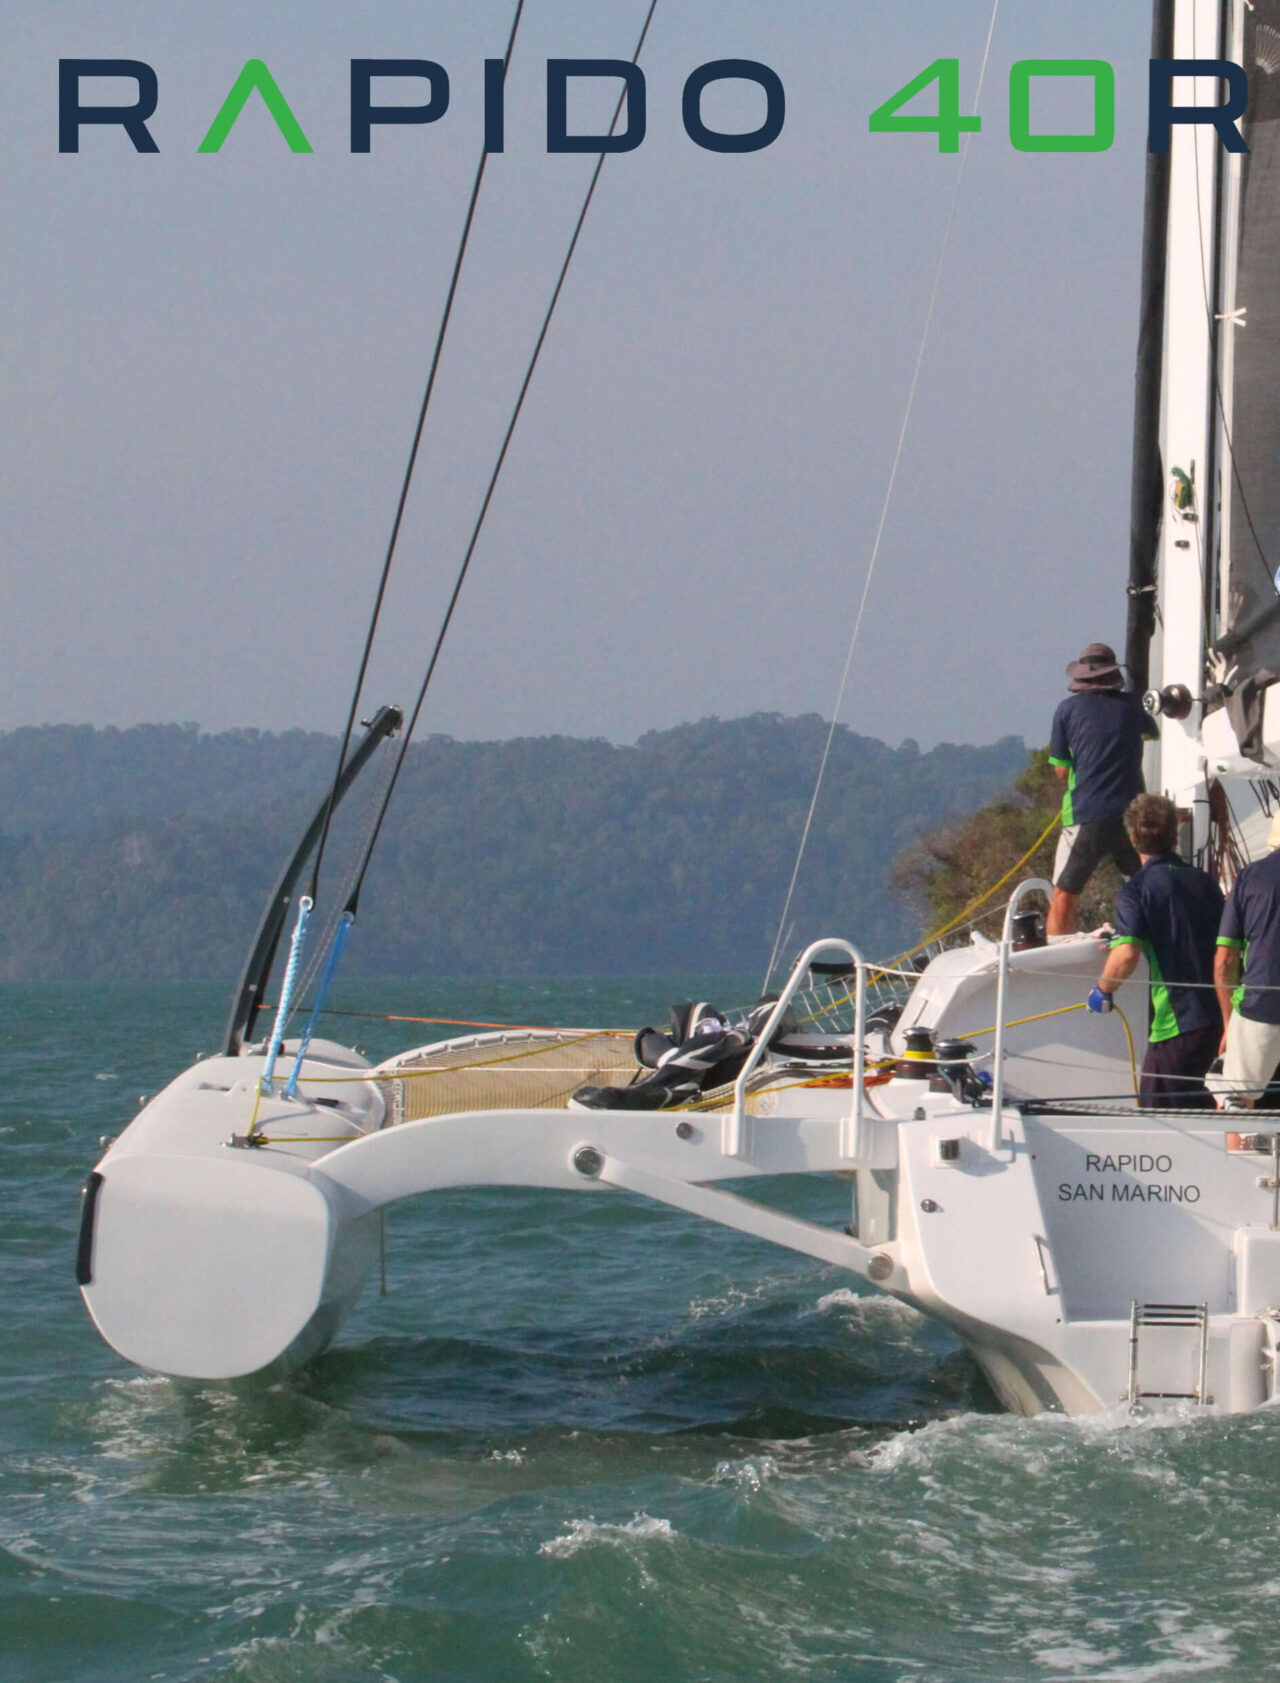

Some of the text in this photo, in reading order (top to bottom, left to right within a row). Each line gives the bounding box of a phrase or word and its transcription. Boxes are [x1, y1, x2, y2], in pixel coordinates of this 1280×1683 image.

[1085, 1154, 1173, 1173] RAPIDO
[1057, 1183, 1201, 1203] SAN MARINO
